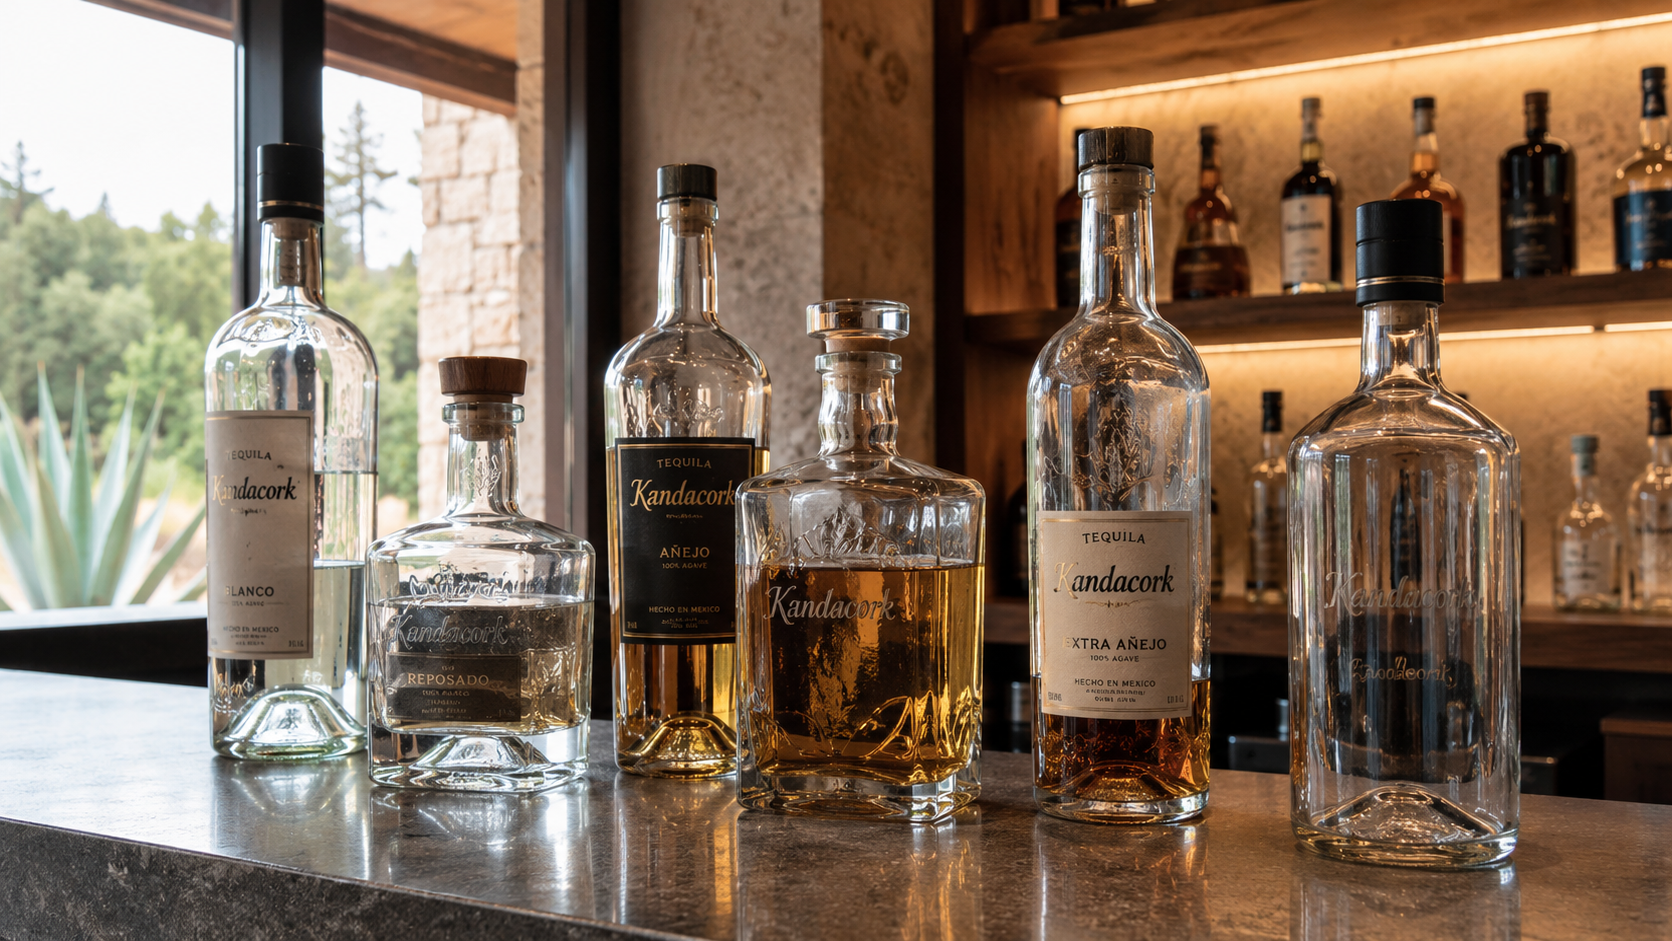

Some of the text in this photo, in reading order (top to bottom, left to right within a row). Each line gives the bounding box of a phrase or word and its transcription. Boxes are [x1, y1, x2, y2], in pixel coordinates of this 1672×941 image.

[226, 449, 272, 461] TEQUILA
[656, 457, 712, 469] TEQUILA
[212, 474, 298, 506] Kandacork
[629, 479, 735, 512] Kandacork
[1082, 531, 1146, 544] TEQUILA
[659, 544, 710, 559] AÑEJO
[1053, 562, 1175, 600] Kandacork
[224, 585, 275, 598] BLANCO
[648, 605, 675, 614] HECHO
[690, 605, 721, 614] MEXICO
[762, 585, 896, 626] Kandacork
[389, 614, 510, 651] Kandacork
[1062, 636, 1167, 651] EXTRA AÑEJO
[1111, 655, 1140, 663] AGAVE
[407, 672, 490, 687] REPOSADO
[1074, 678, 1156, 688] HECHO EN MEXICO
